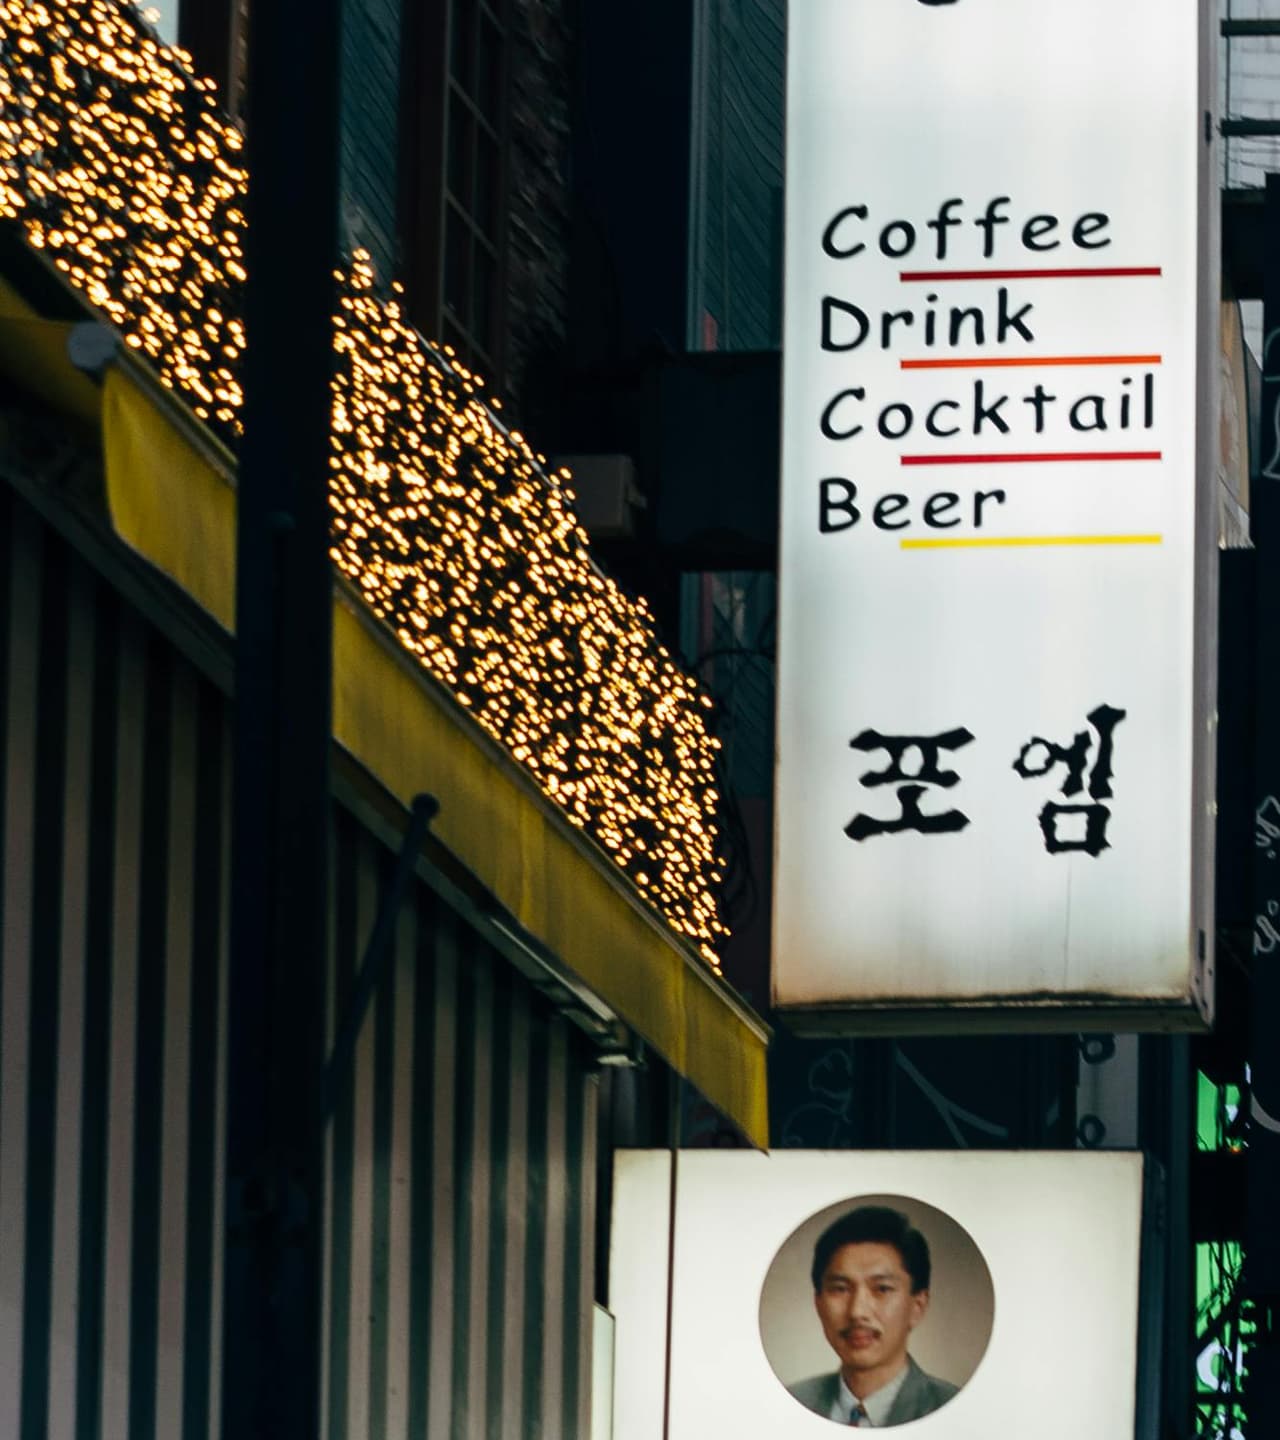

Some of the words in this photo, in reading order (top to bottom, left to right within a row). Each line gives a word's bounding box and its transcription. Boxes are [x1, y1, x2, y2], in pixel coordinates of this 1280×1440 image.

[822, 198, 1113, 260] Coffee
[819, 290, 1035, 356] Drink
[819, 372, 1156, 442] Cocktail
[818, 474, 1006, 533] Beer
[844, 705, 1127, 857] 포엠
